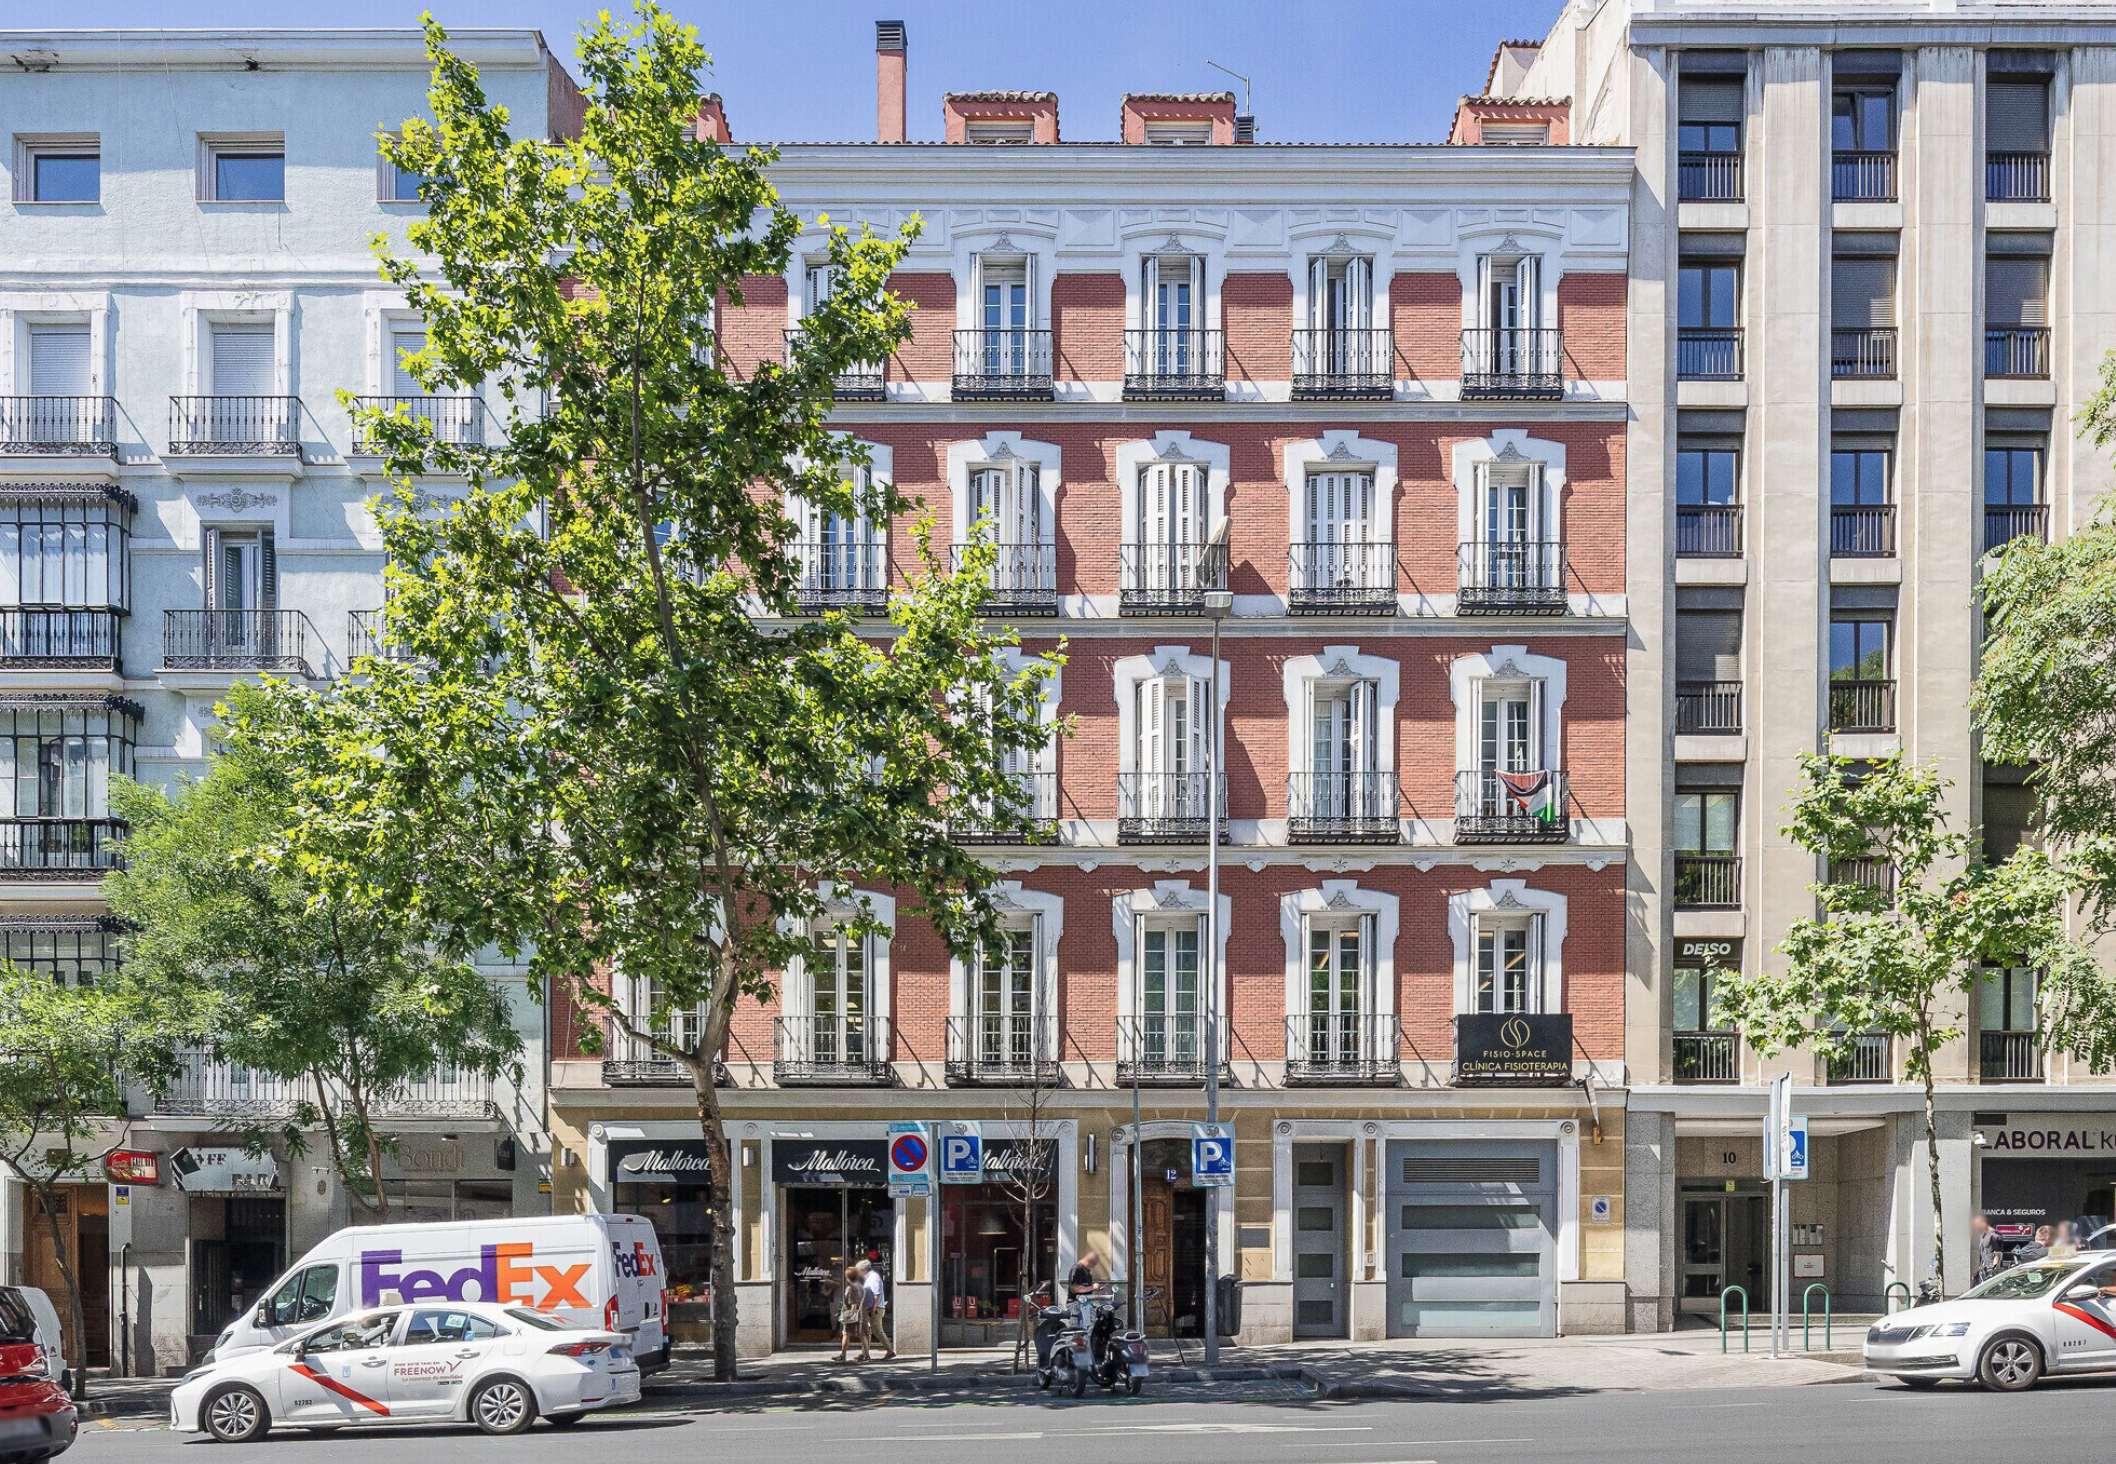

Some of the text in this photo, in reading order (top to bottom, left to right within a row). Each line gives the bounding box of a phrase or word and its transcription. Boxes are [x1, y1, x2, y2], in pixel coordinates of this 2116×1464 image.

[1462, 1060, 1568, 1071] CLÍNICA FISIOTERAPIA
[1980, 1131, 2095, 1150] LABORAL
[948, 1139, 970, 1168] P
[1200, 1142, 1223, 1171] P
[1723, 1152, 1736, 1163] 10
[1166, 1169, 1177, 1180] 12
[612, 1242, 657, 1278] FedEx
[361, 1242, 593, 1310] FedEx
[394, 1366, 446, 1376] FREENOW
